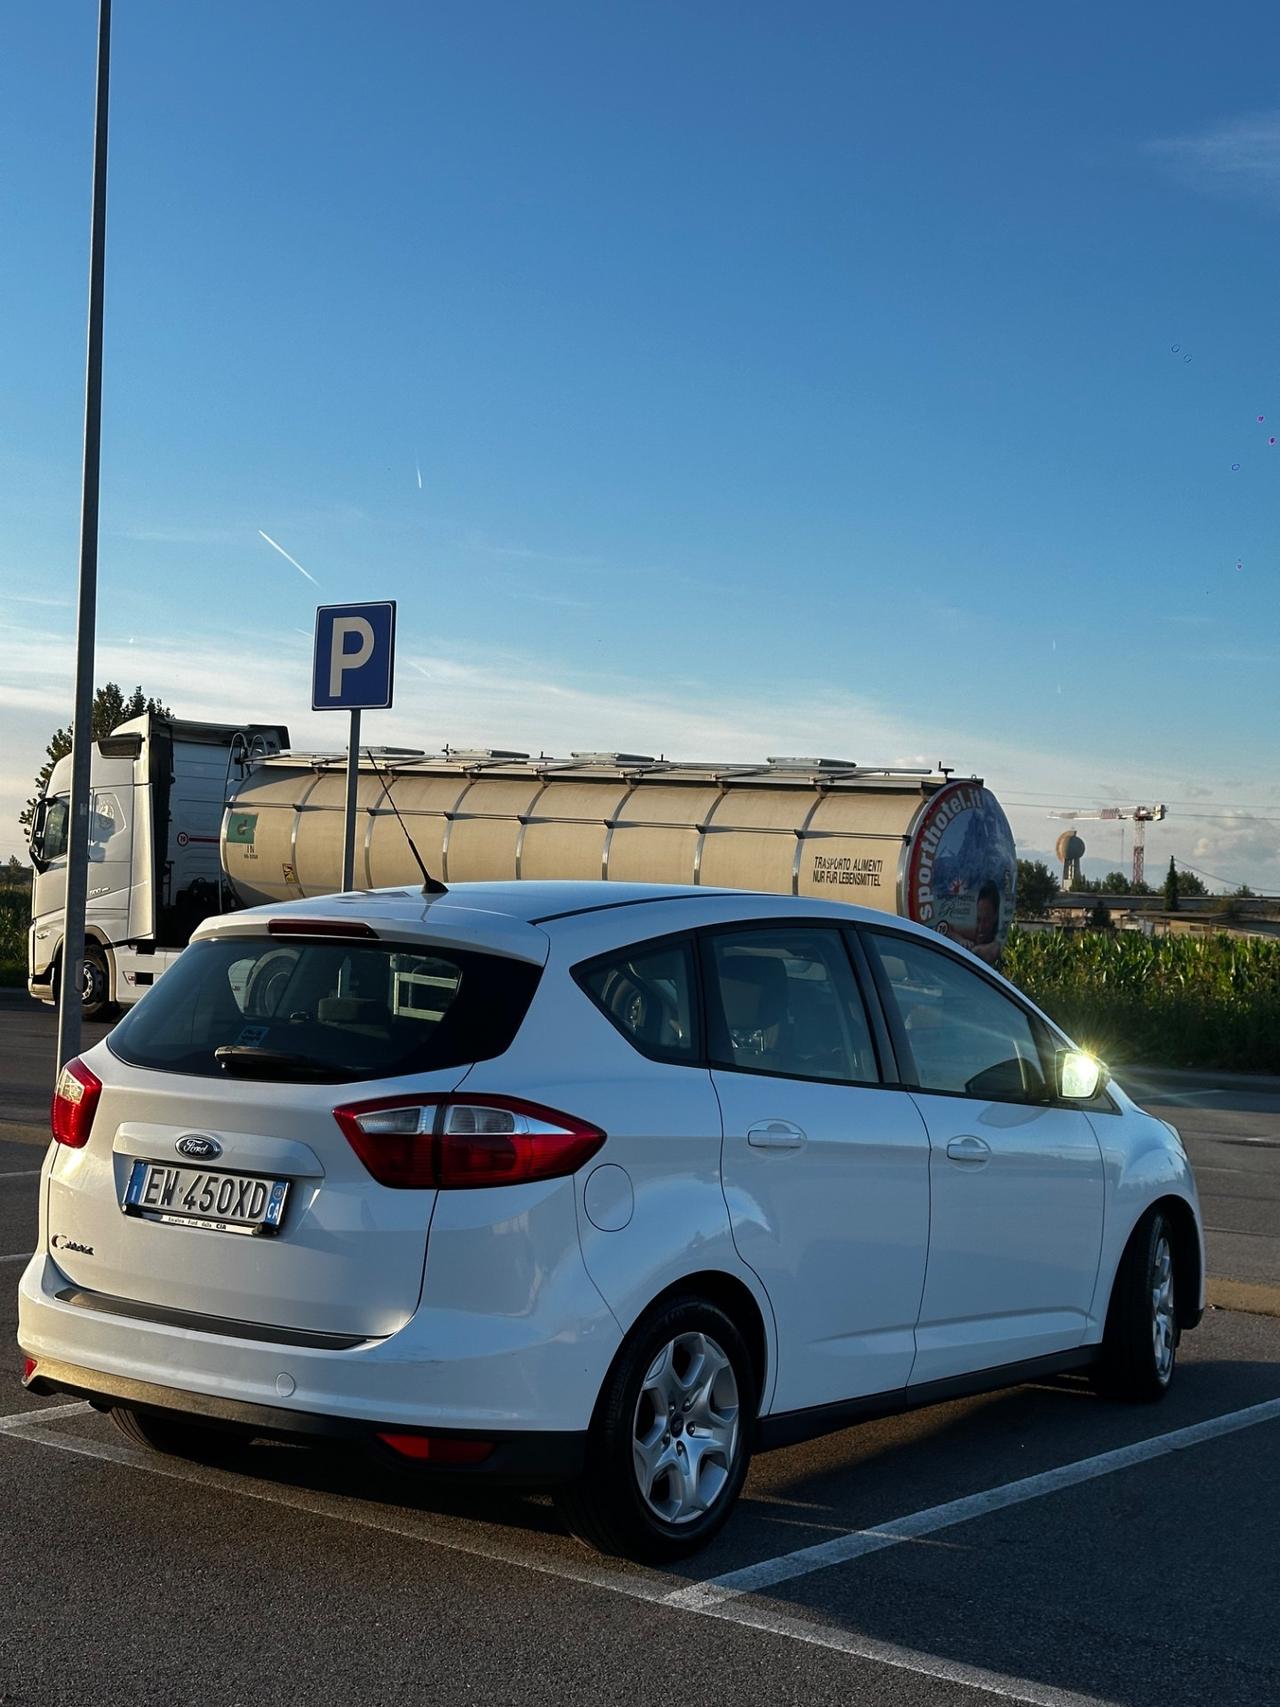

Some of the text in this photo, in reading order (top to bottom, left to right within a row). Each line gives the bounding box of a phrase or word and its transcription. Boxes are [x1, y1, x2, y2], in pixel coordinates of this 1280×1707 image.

[329, 616, 375, 697] P
[815, 856, 883, 872] TRASPORTO ALIMENTI
[813, 870, 826, 883] NUR
[839, 872, 881, 887] LEBENSMITTEL
[183, 1139, 209, 1154] Ford
[142, 1167, 268, 1219] EW 450XD
[267, 1202, 279, 1220] CA
